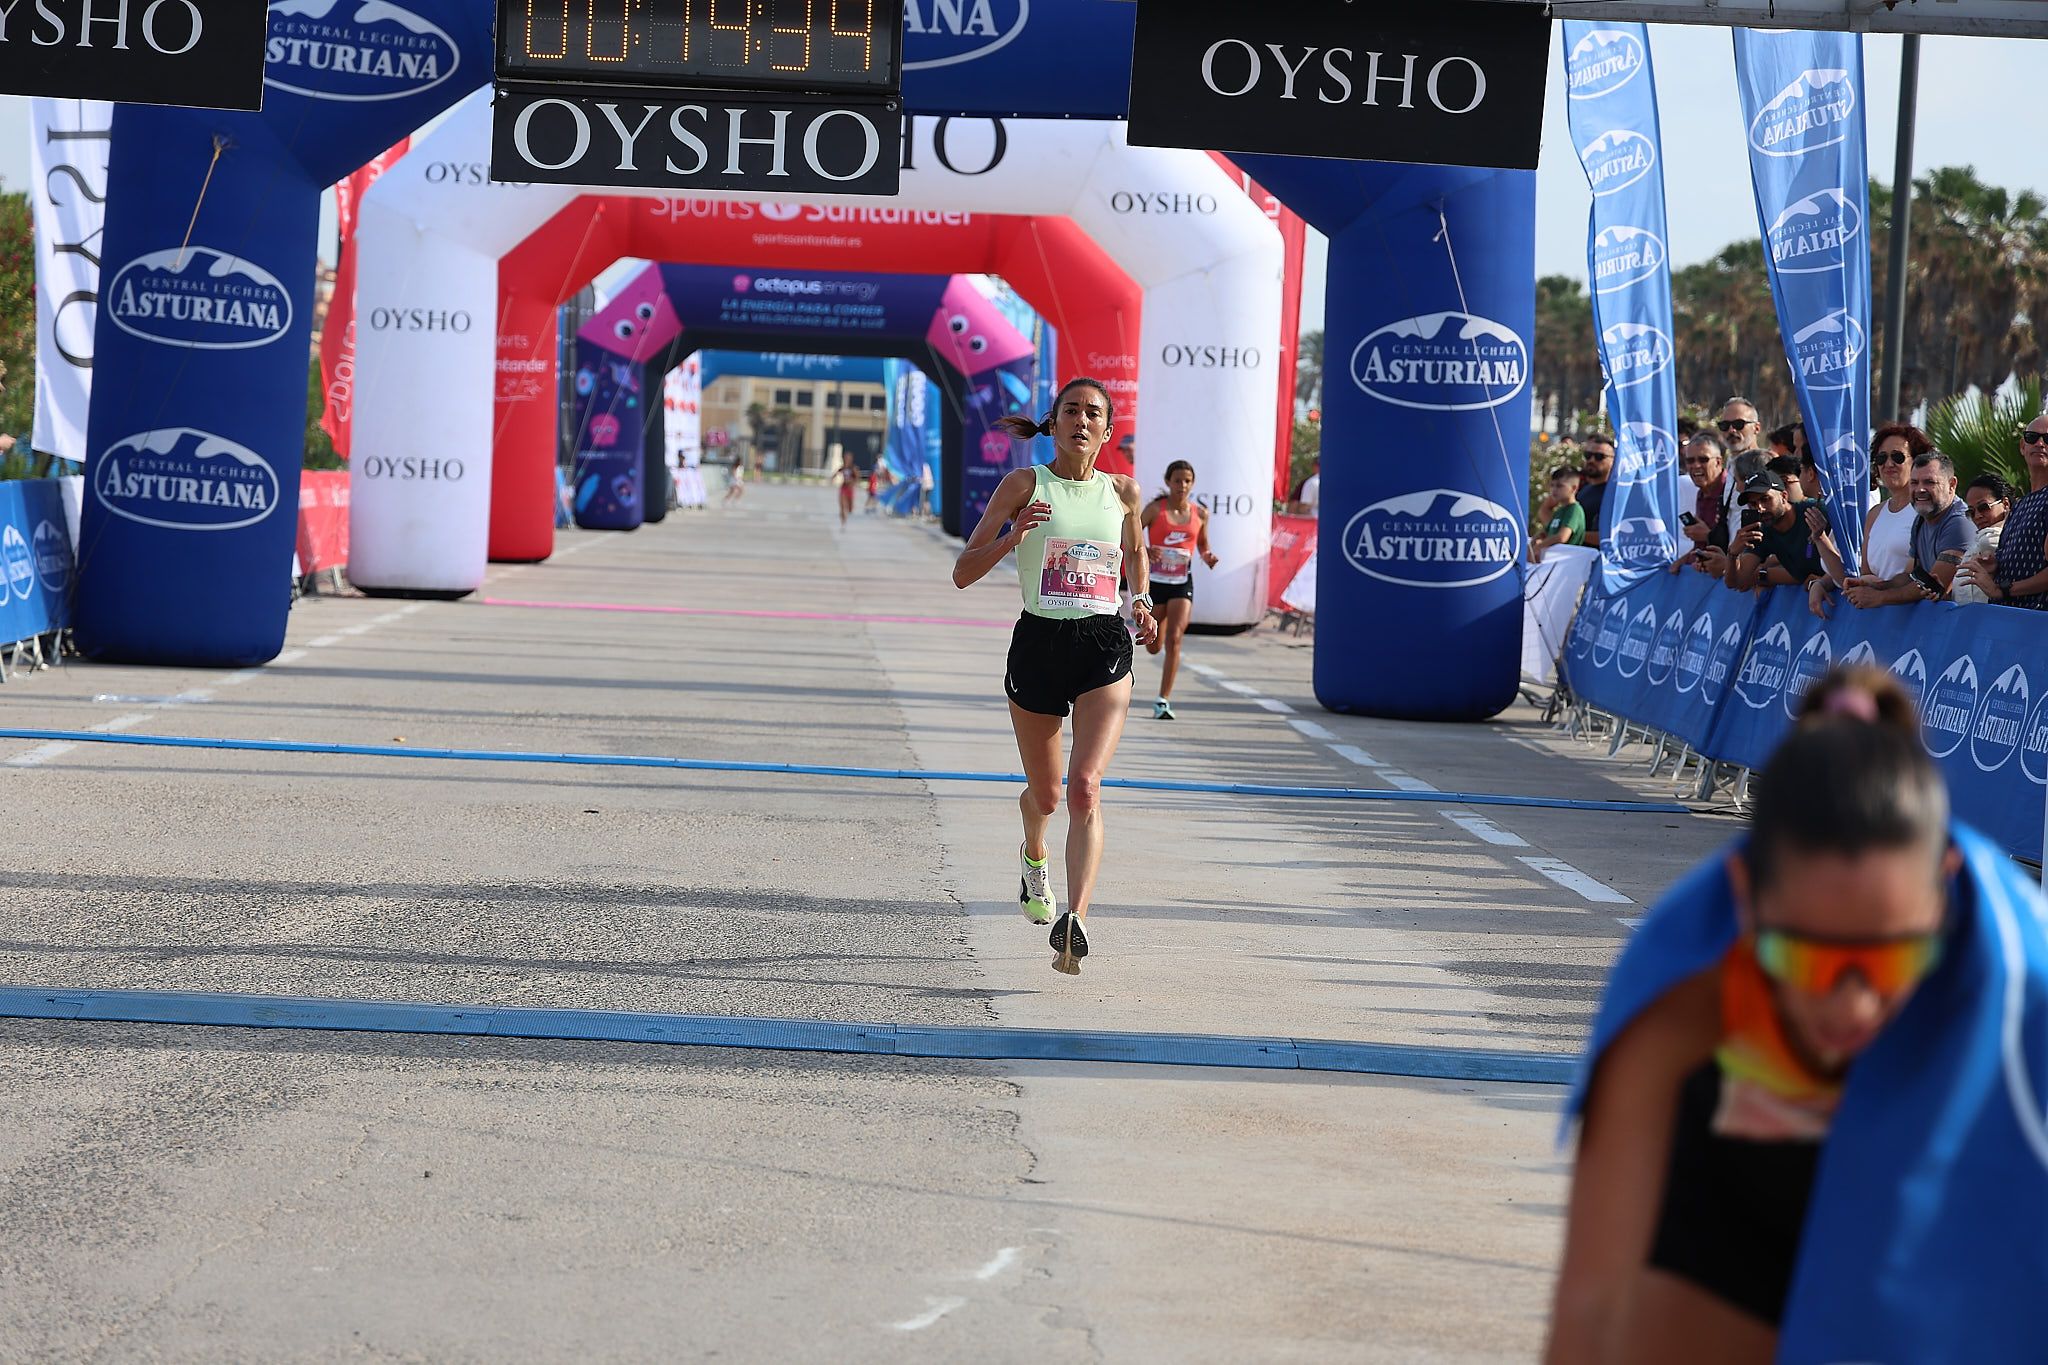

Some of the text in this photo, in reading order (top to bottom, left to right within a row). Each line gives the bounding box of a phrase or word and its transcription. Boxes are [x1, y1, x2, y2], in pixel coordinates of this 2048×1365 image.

[273, 22, 438, 50] CENTRAL LECHERA
[1201, 38, 1487, 114] OYSHO
[513, 98, 881, 182] OYSHO
[1111, 190, 1218, 216] OYSHO
[752, 232, 863, 249] sportssantander.es
[142, 277, 278, 300] CENTRAL LECHERA
[116, 278, 281, 331] ASTURIANA
[370, 307, 472, 333] OYSHO
[1087, 352, 1137, 370] Sports
[1161, 343, 1262, 369] OYSHO
[1392, 343, 1518, 357] CENTRAL LECHERA
[1361, 346, 1521, 386] ASTURIANA
[128, 458, 265, 481] CENTRAL LECHERA
[364, 455, 466, 482] OYSHO
[102, 459, 267, 511] ASTURIANA
[1382, 521, 1511, 534] CENTRAL LECHERA
[1353, 522, 1513, 562] ASTURIANA
[1066, 571, 1097, 585] 016
[1047, 599, 1074, 607] OYSHO
[1973, 700, 2021, 746] ASTURIANA
